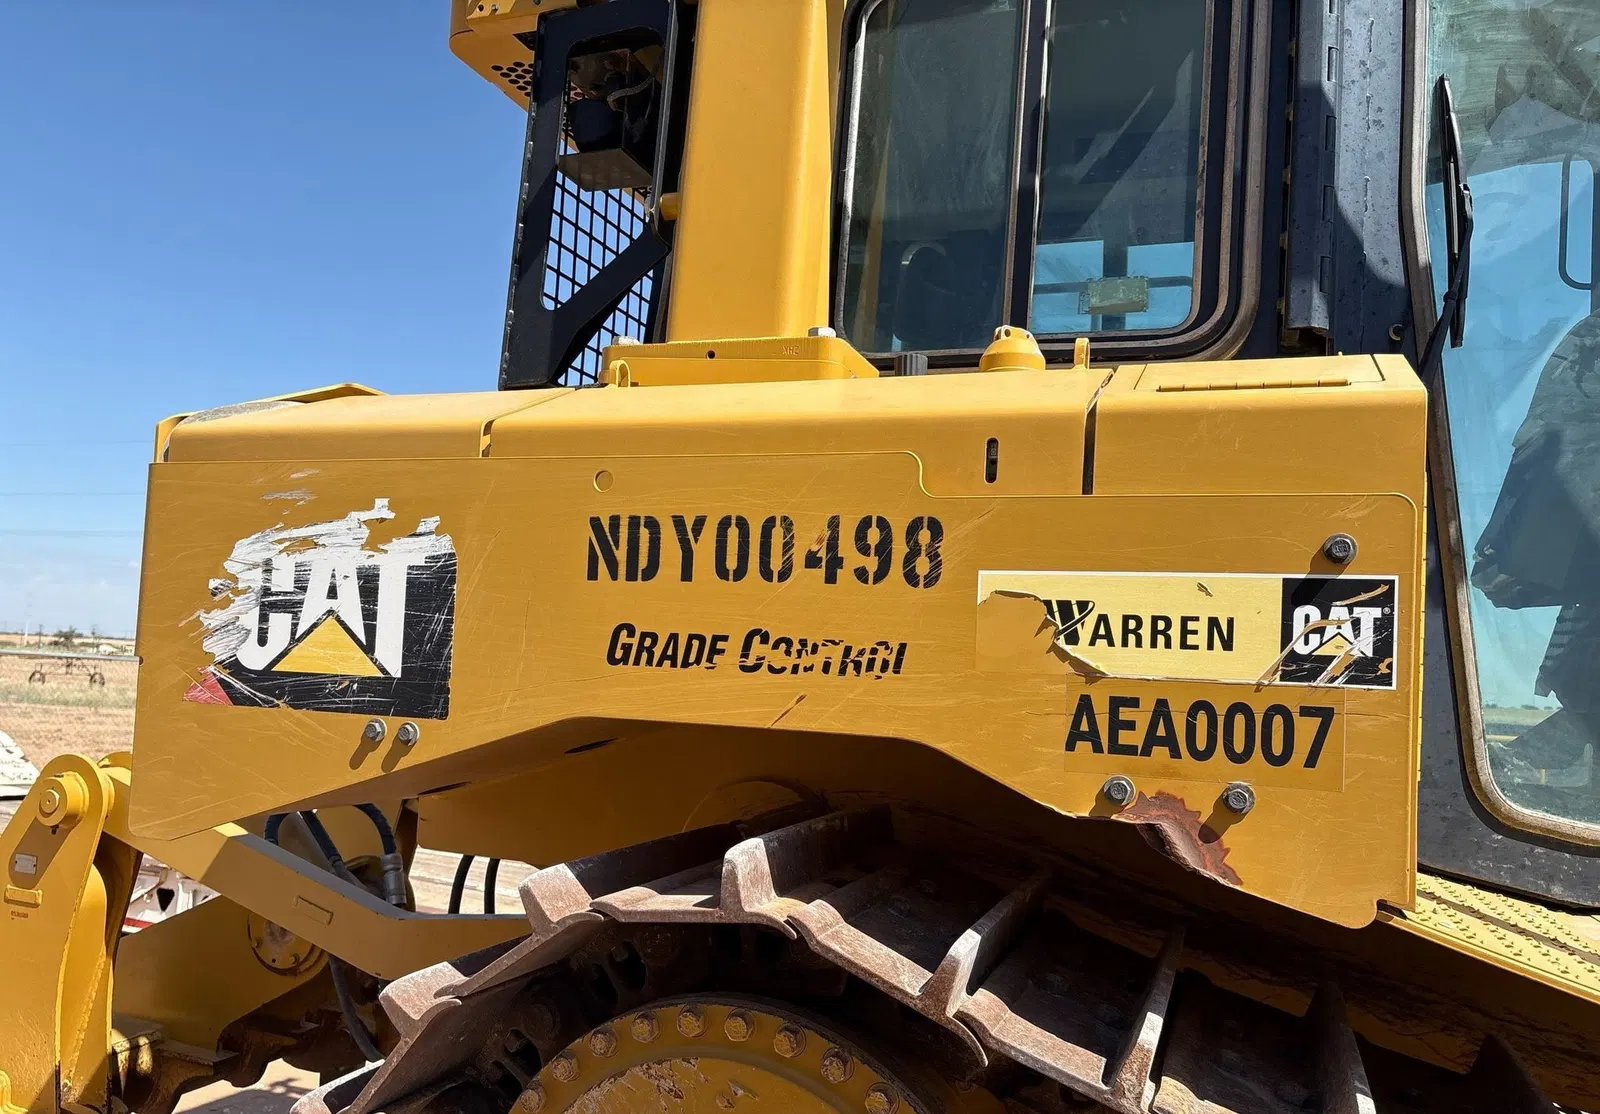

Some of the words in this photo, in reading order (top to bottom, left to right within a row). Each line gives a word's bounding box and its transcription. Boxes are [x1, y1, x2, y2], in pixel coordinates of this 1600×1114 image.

[586, 514, 944, 589] NDY00498
[232, 548, 426, 678] CAT
[606, 622, 729, 670] GRADE
[1042, 599, 1235, 652] WARREN
[1065, 693, 1336, 769] AEA0007
